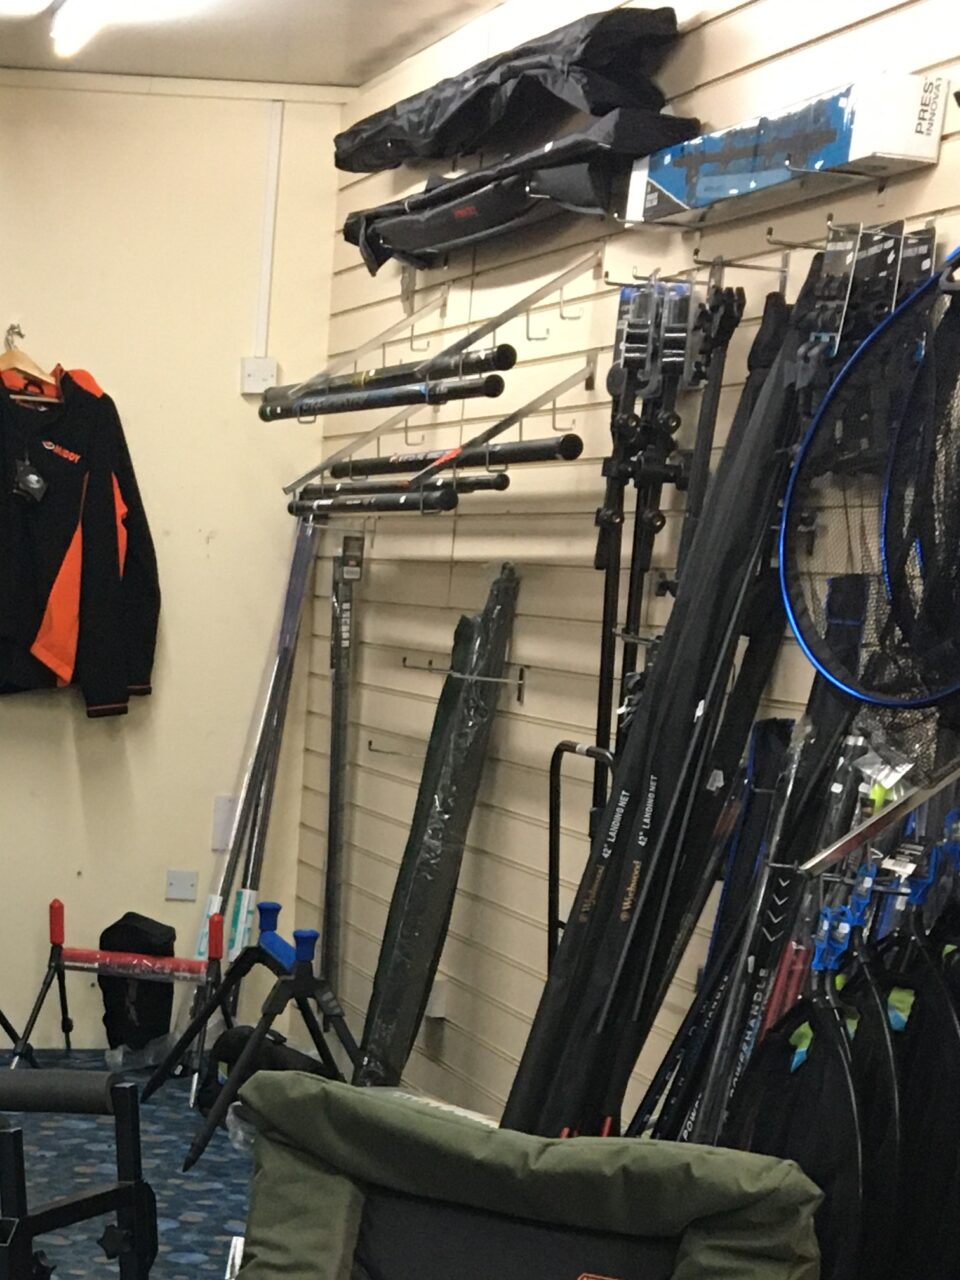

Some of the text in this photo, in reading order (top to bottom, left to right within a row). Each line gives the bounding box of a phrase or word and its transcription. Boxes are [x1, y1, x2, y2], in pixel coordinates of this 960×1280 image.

[915, 77, 934, 135] PRES
[607, 806, 625, 843] LANDING
[619, 790, 630, 807] NET
[642, 793, 656, 829] LANDING
[650, 775, 658, 793] NET
